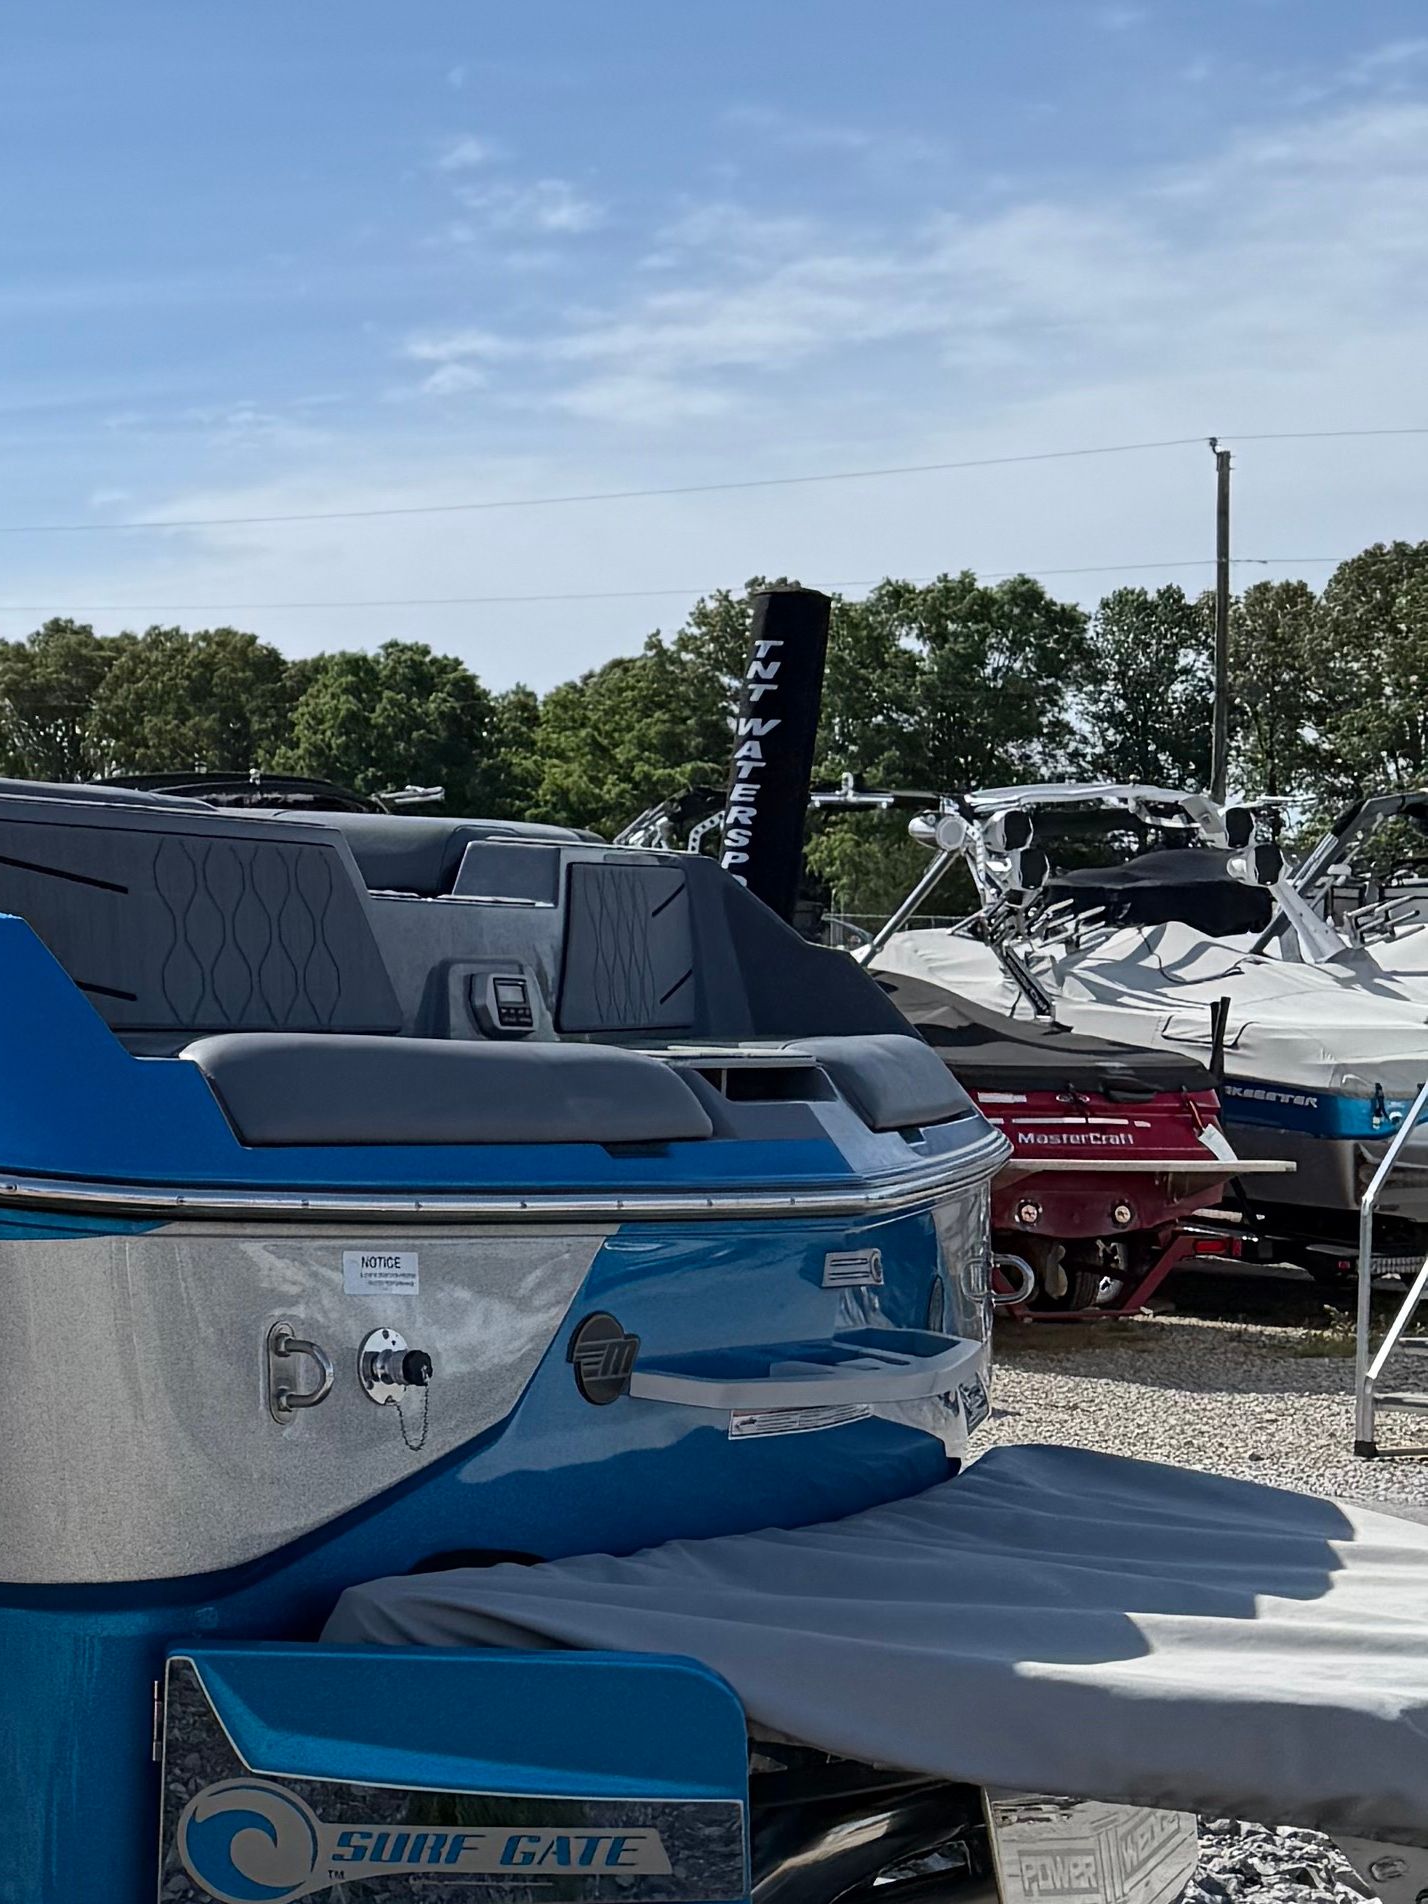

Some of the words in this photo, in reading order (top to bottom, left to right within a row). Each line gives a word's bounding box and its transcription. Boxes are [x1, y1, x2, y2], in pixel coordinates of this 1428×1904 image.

[746, 640, 784, 702] TNT
[1017, 1132, 1135, 1146] MasterCraft
[361, 1256, 401, 1269] NOTICE
[331, 1830, 486, 1865] SURF
[499, 1834, 647, 1868] GATE
[327, 1869, 346, 1880] TM
[1021, 1853, 1099, 1892] POWER
